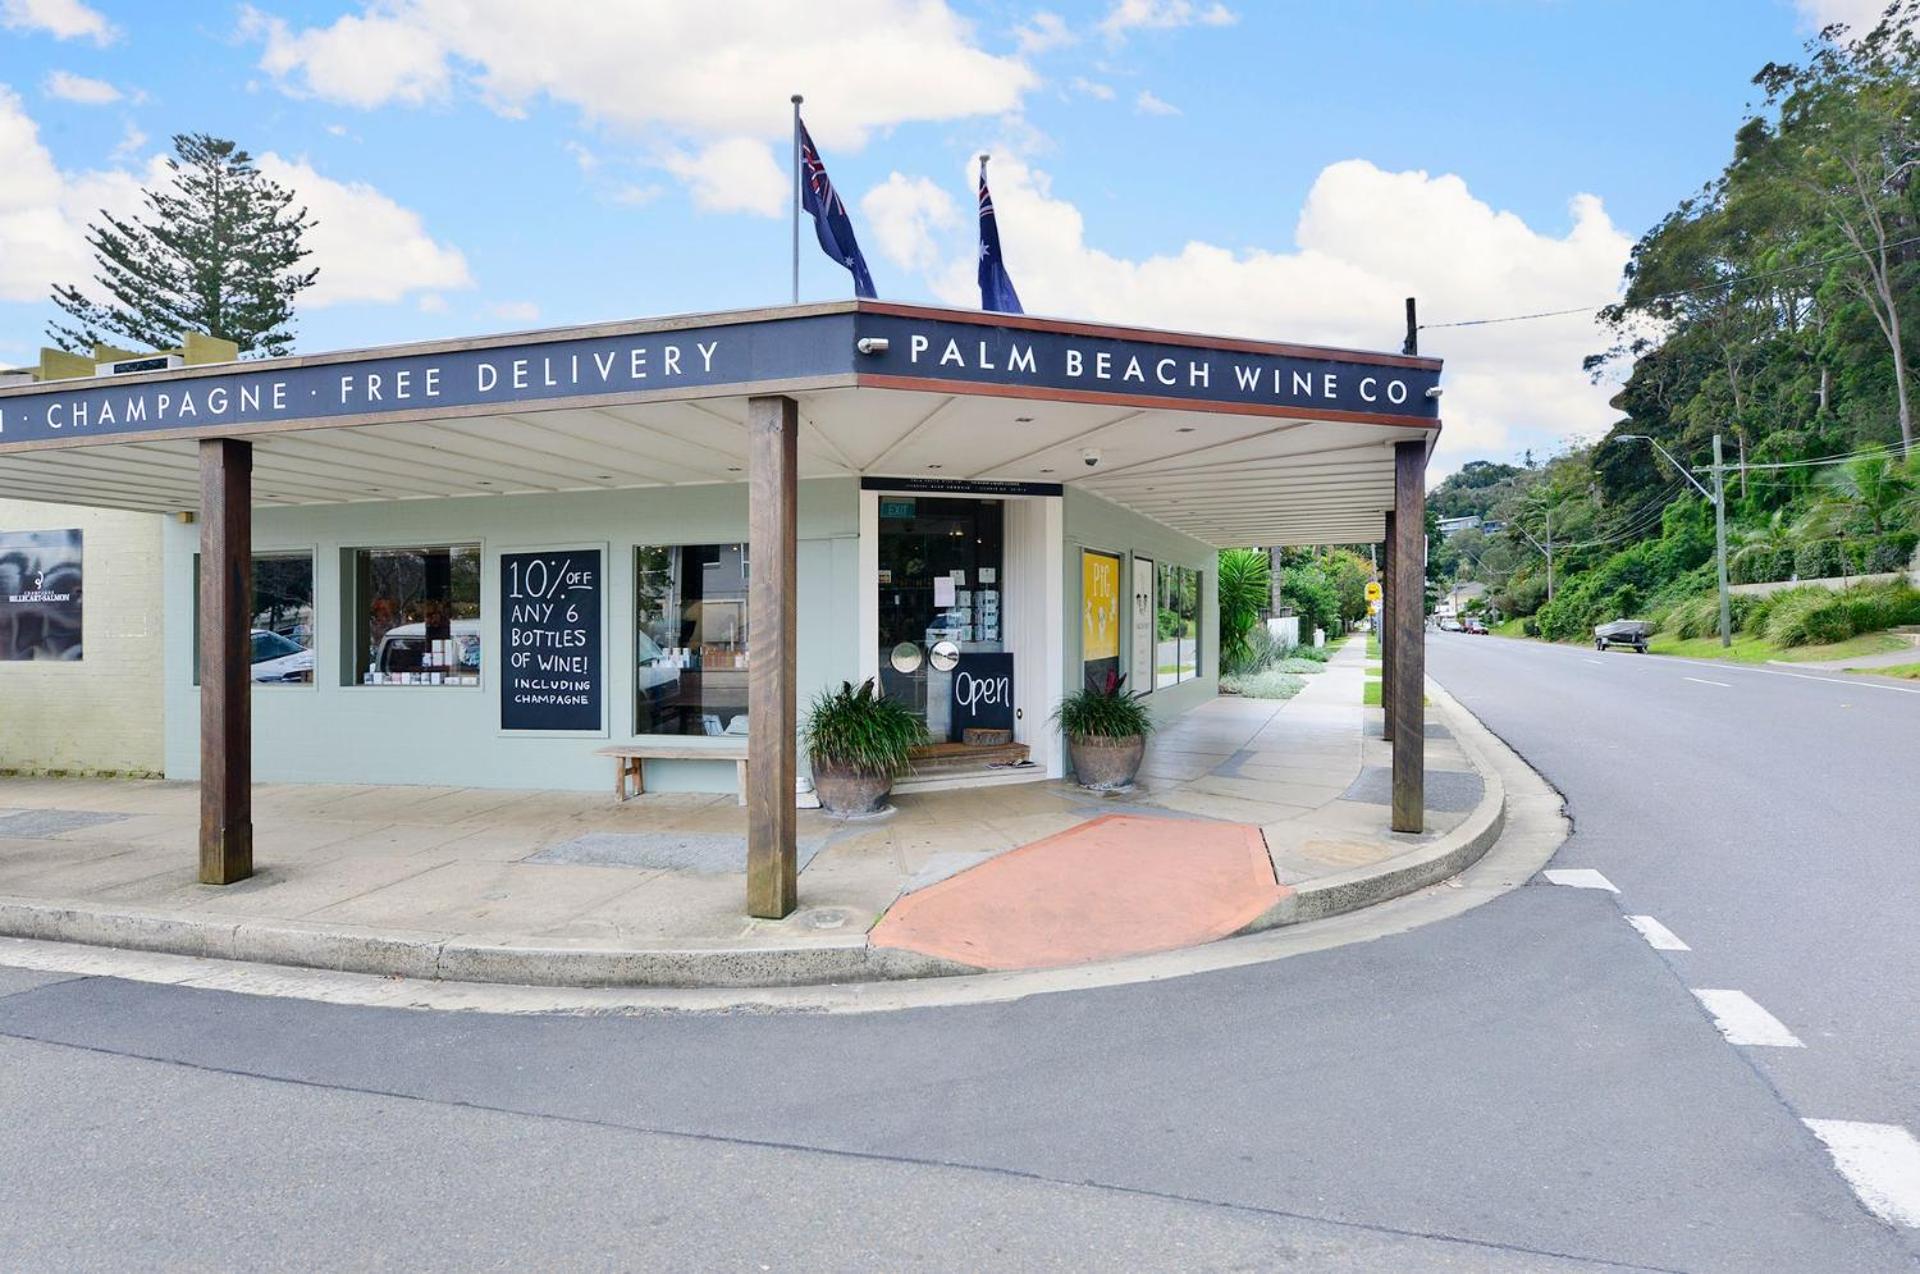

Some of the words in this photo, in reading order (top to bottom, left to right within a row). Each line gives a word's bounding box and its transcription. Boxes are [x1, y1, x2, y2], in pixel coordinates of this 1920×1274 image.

[911, 335, 1037, 373] PALM
[1066, 349, 1210, 388] BEACH
[1234, 365, 1338, 398] WINE
[1359, 377, 1408, 404] CO
[47, 384, 287, 429] CHAMPAGNE
[341, 368, 441, 404] FREE
[478, 341, 719, 392] DELIVERY
[510, 559, 571, 601] 10%
[566, 571, 593, 587] OFF
[511, 603, 553, 624] ANY
[566, 604, 579, 623] 6
[511, 628, 586, 648] BOTTLES
[511, 651, 531, 669] OF
[537, 655, 588, 674] WINE!
[514, 677, 591, 691] INCLUDING
[955, 671, 1010, 716] Open
[514, 694, 589, 705] CHAMPAGNE
